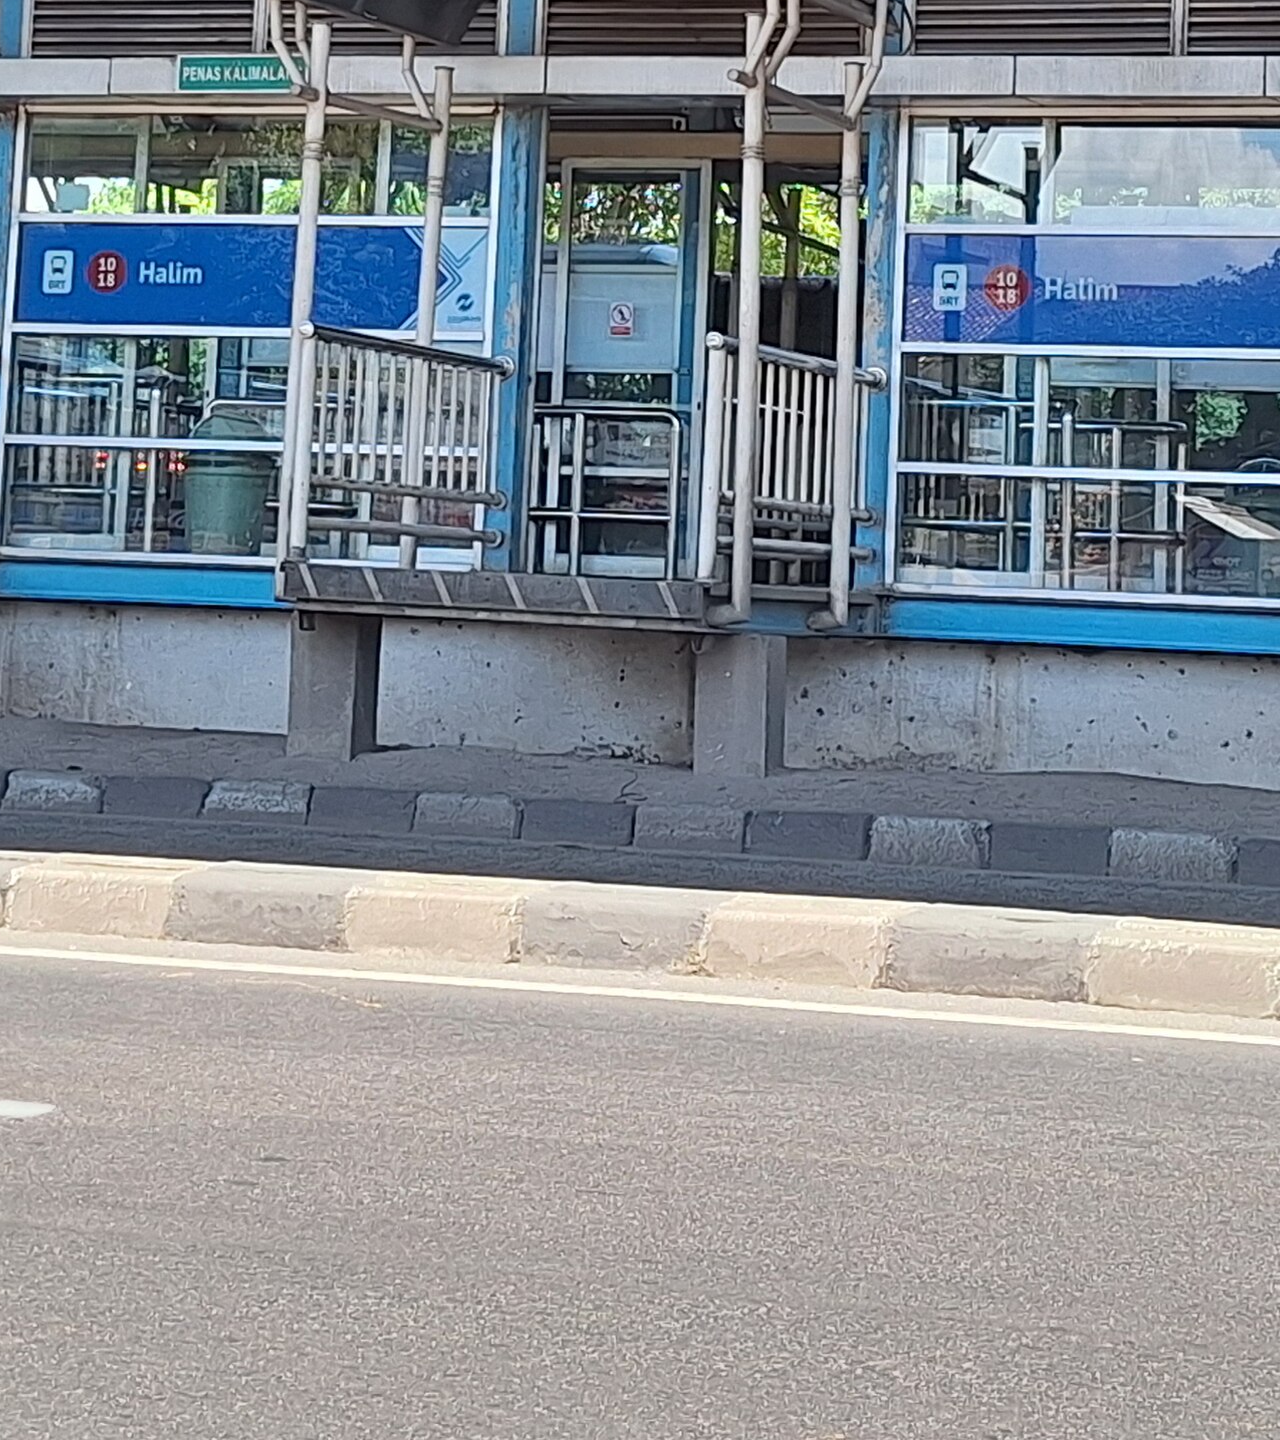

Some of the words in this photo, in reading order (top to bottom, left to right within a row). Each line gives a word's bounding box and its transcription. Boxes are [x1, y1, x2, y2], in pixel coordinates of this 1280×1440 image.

[182, 65, 222, 81] PENAS
[97, 257, 117, 271] 10
[138, 261, 203, 285] Halim
[97, 273, 116, 287] 18
[995, 271, 1017, 287] 10
[1044, 277, 1118, 301] Halim
[996, 288, 1017, 304] 18
